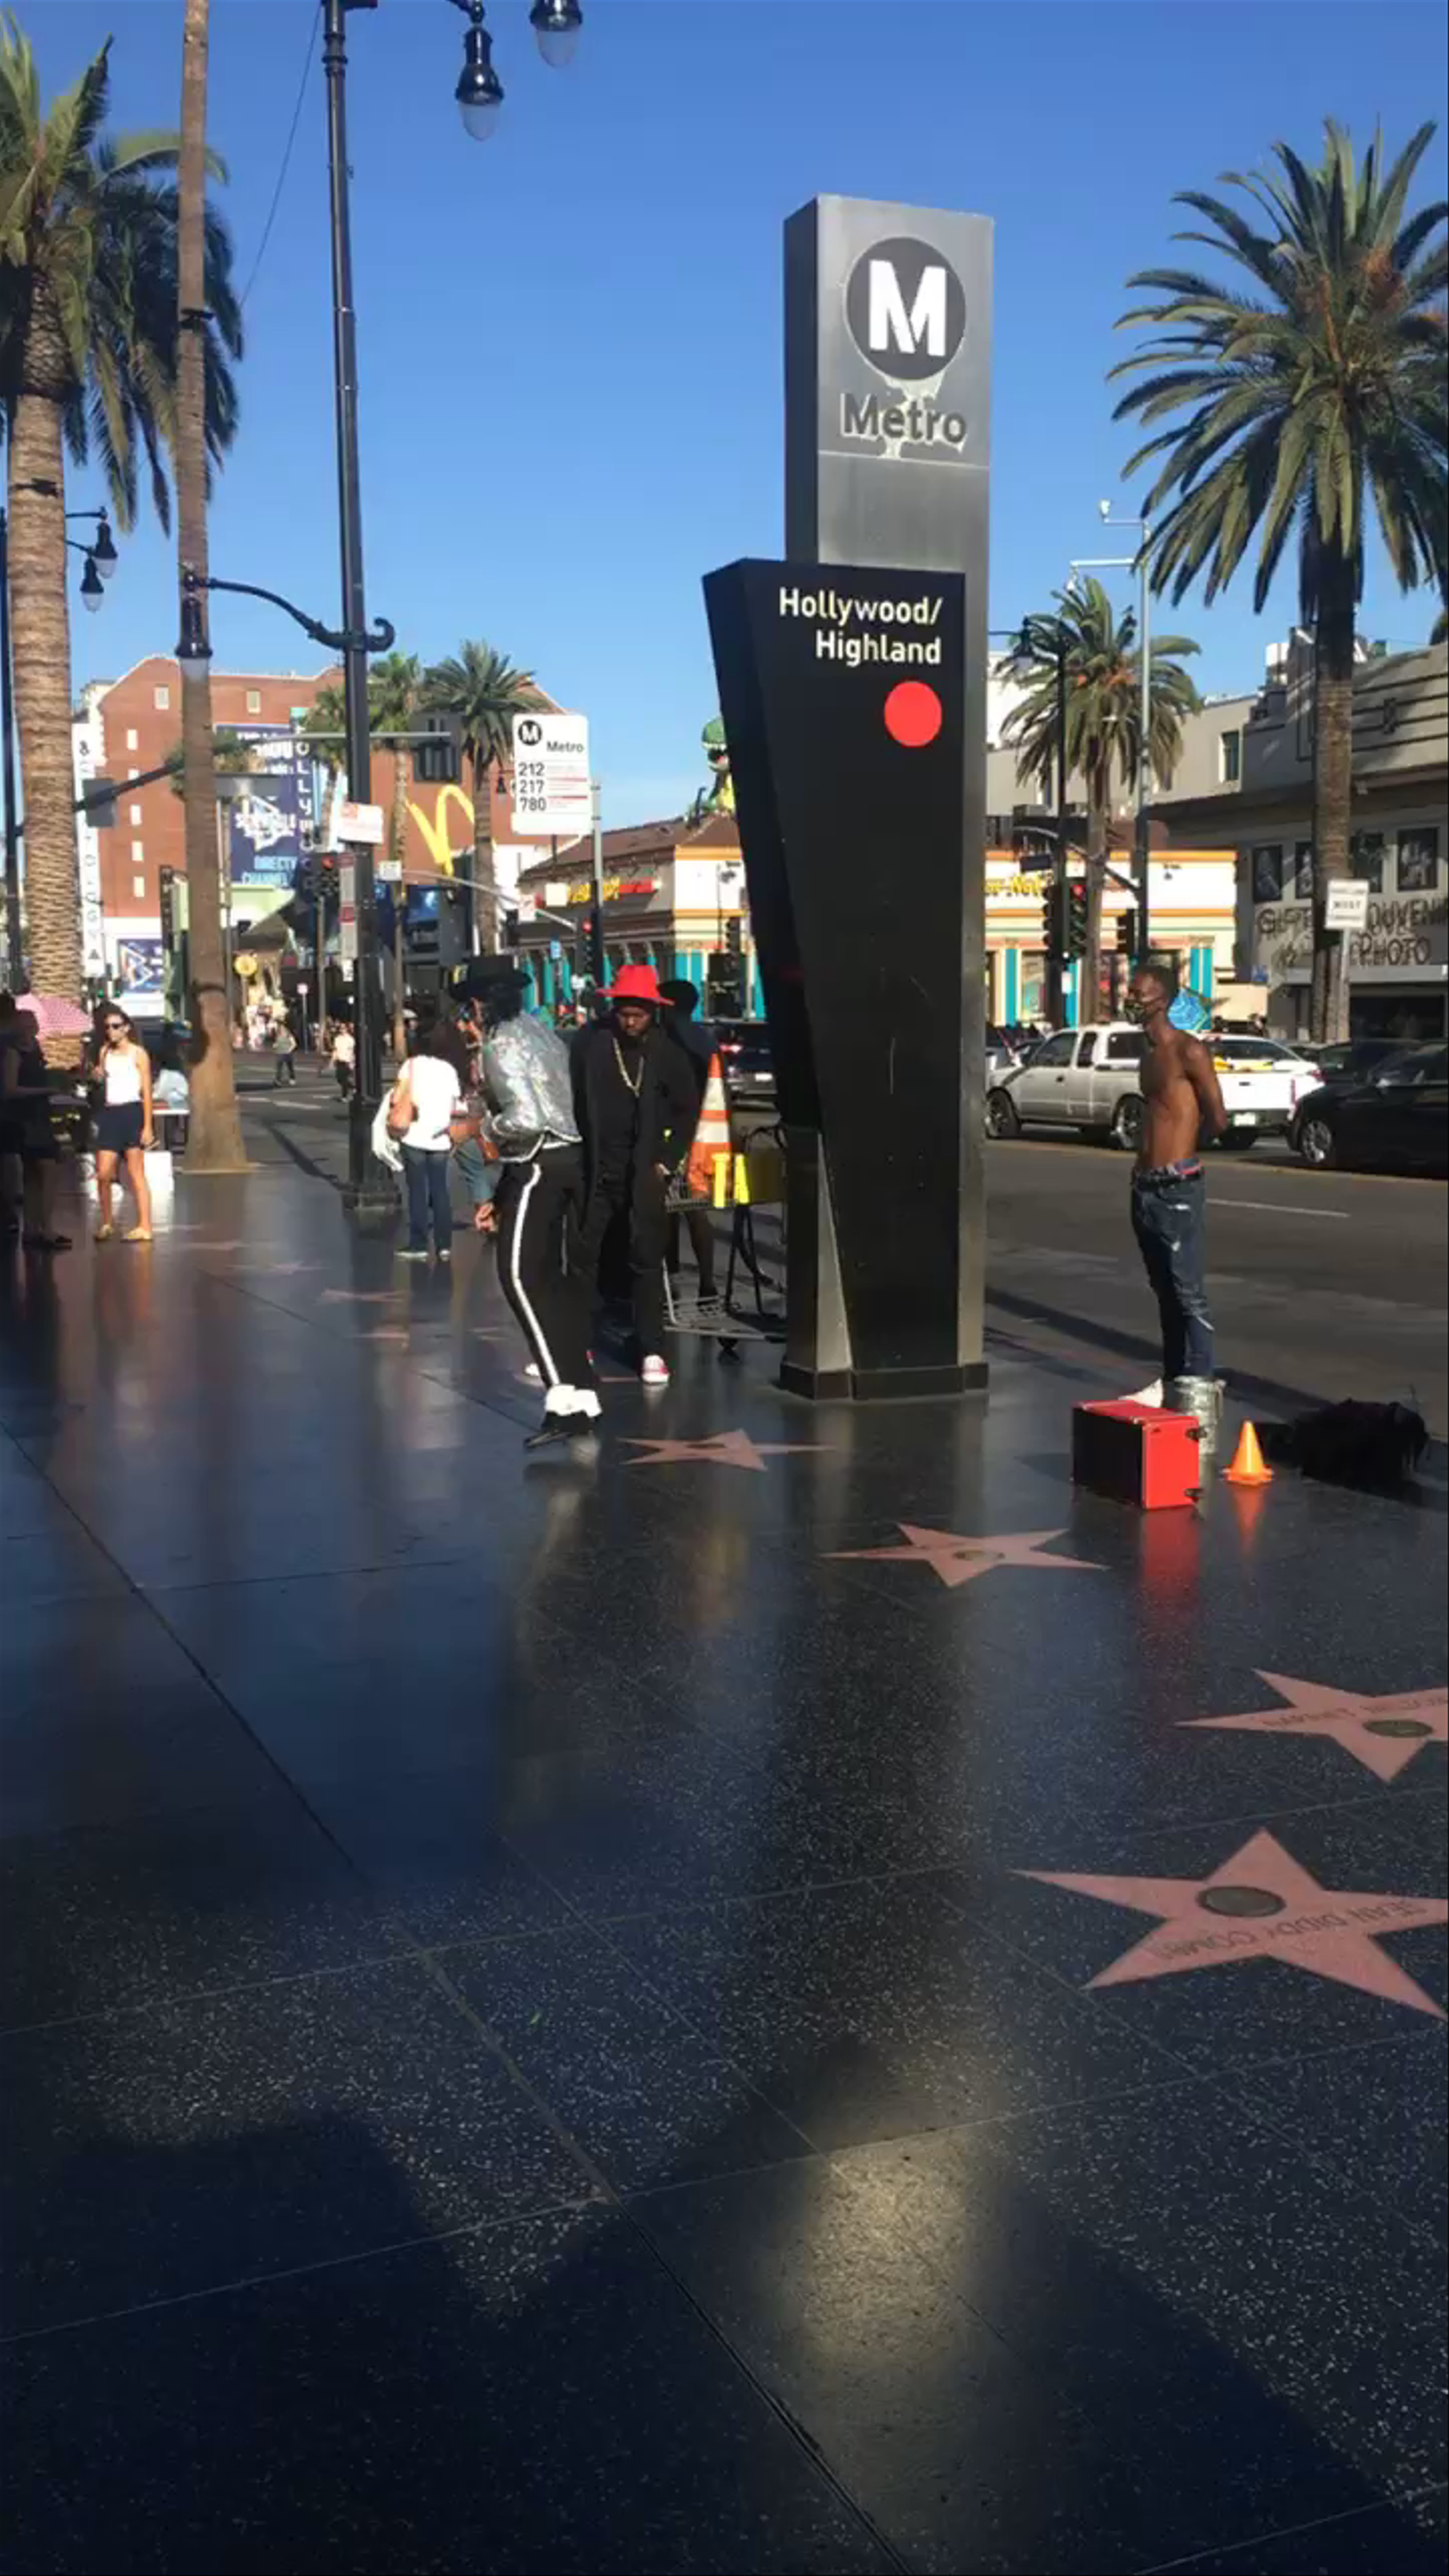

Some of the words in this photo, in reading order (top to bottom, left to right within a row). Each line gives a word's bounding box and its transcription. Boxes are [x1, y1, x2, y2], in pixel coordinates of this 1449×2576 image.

[869, 259, 946, 357] M
[841, 392, 967, 444] Metro
[780, 587, 942, 626] Hollywood/
[816, 630, 941, 667] Highland
[547, 741, 584, 752] Metro
[518, 762, 545, 776] 212
[520, 780, 544, 793] 217
[520, 797, 546, 811] 780
[1360, 933, 1431, 966] PHOTO
